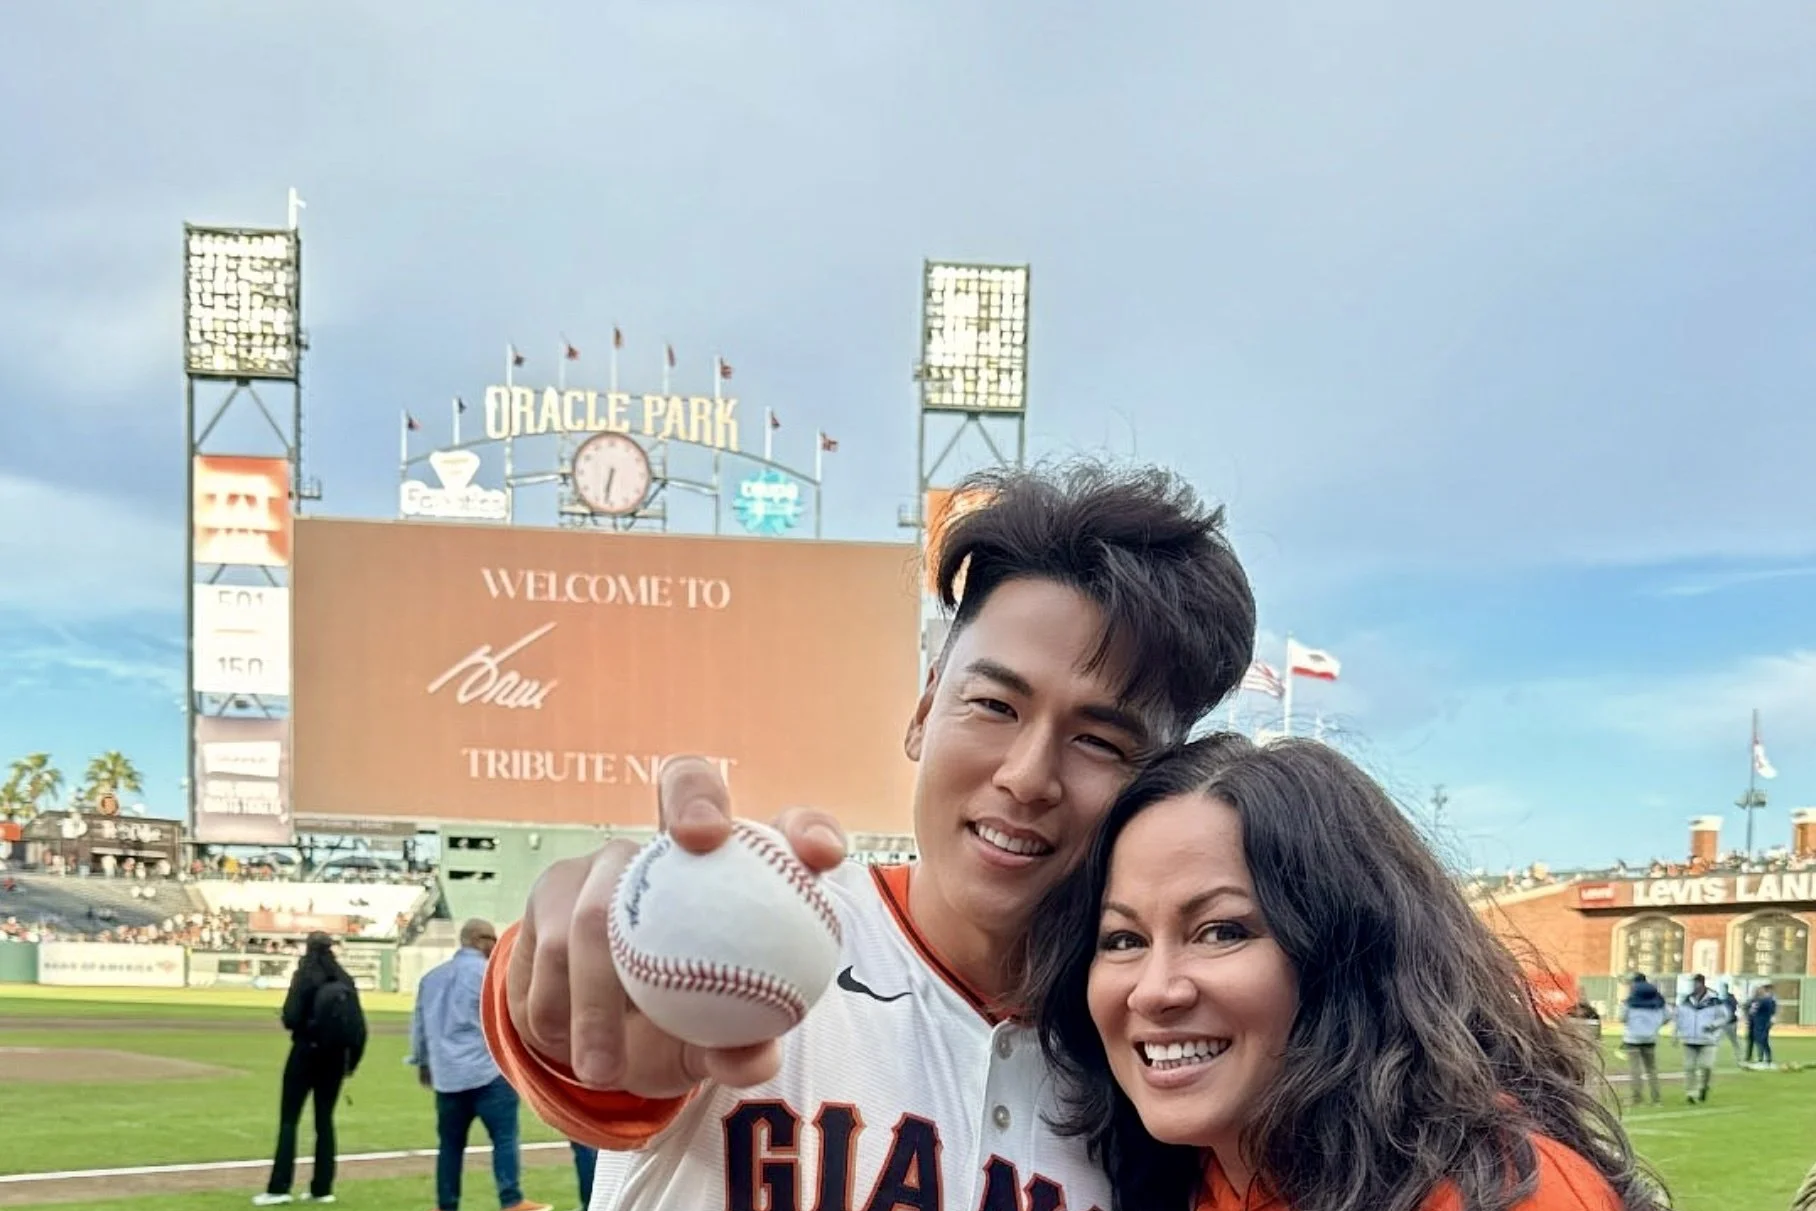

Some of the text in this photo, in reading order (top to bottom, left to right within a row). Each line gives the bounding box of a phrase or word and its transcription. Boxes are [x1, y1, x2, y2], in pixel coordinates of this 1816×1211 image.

[486, 385, 740, 452] ORACLE PARK
[481, 567, 731, 609] WELCOME TO
[461, 747, 739, 787] TRIBUTE NIT
